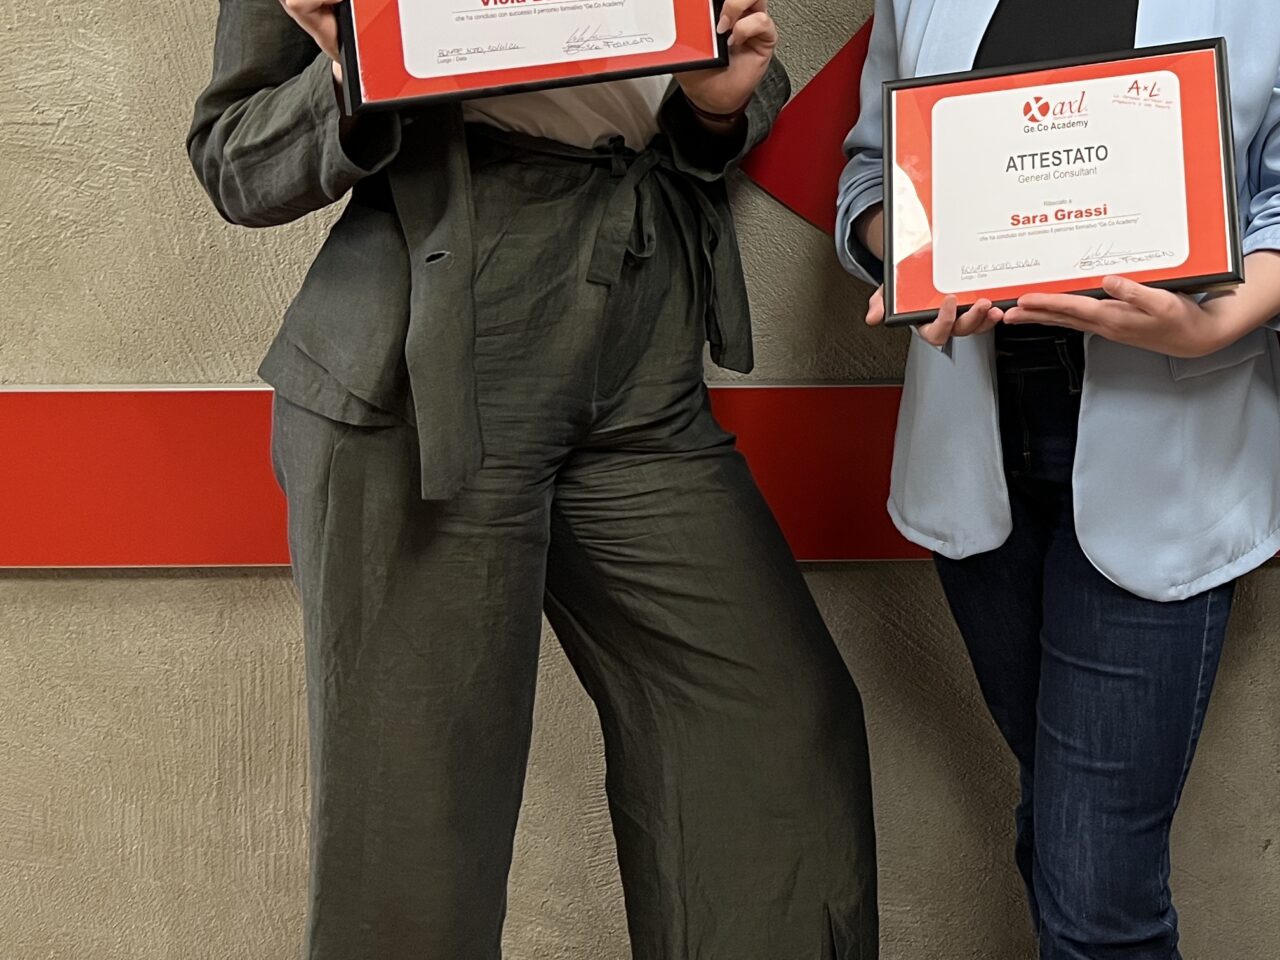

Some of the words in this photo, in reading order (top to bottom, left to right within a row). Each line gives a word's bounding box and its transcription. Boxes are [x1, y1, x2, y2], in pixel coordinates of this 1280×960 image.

[1050, 120, 1088, 130] Academy
[1006, 145, 1108, 172] ATTESTATO
[1018, 172, 1050, 184] General
[1053, 166, 1098, 180] Consultant
[1010, 214, 1048, 226] Sara
[1054, 204, 1108, 220] Grassi
